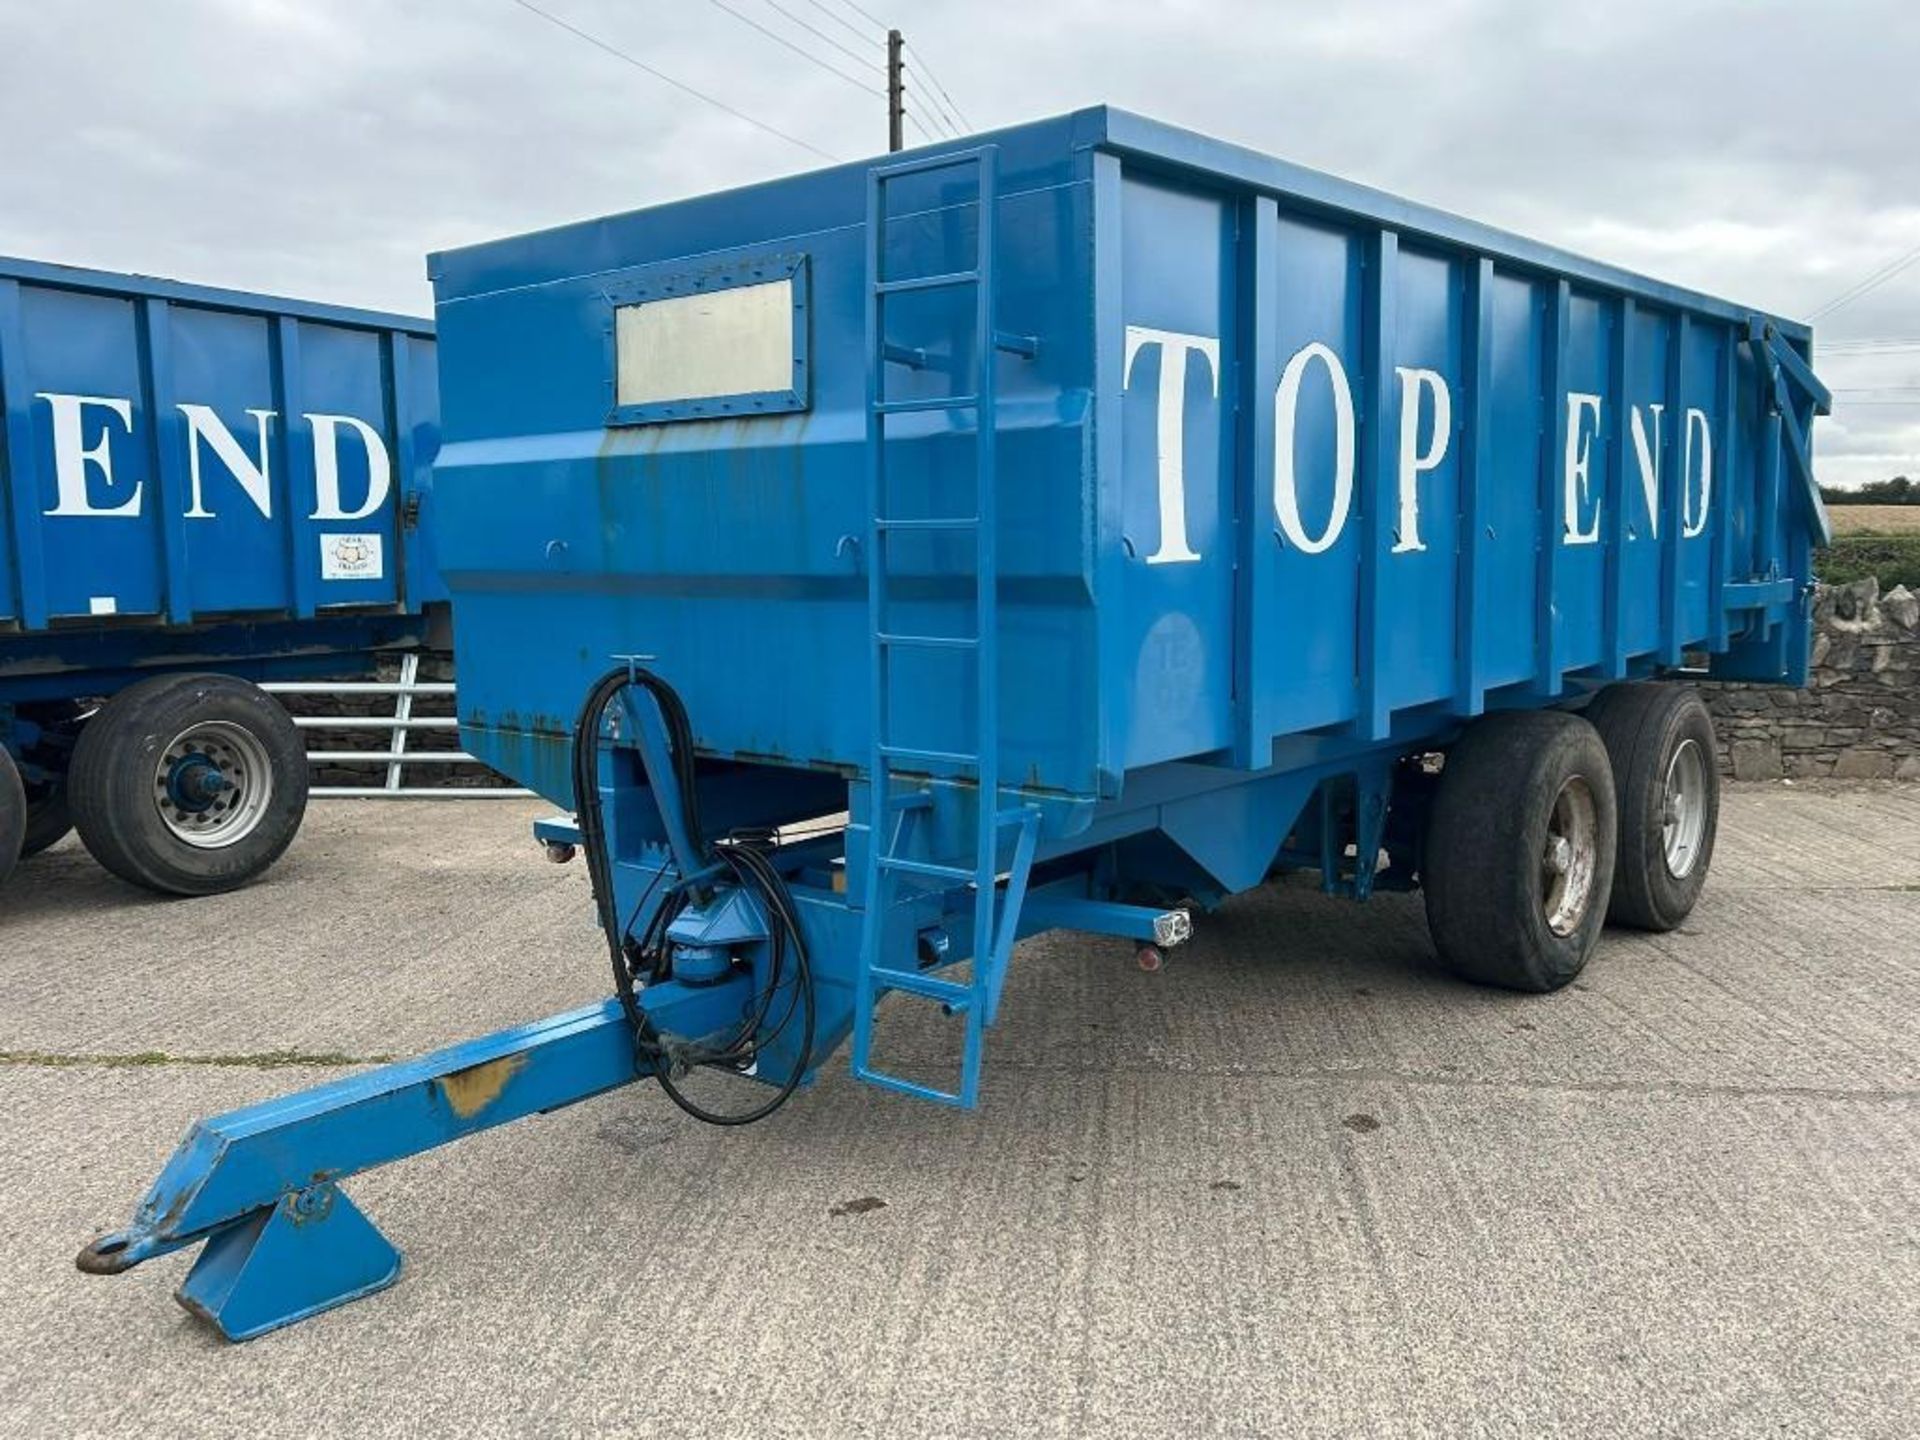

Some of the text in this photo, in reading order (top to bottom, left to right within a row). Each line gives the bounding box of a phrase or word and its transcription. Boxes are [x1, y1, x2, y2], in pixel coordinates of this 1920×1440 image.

[34, 392, 391, 519] END
[1123, 326, 1712, 564] TOP END
